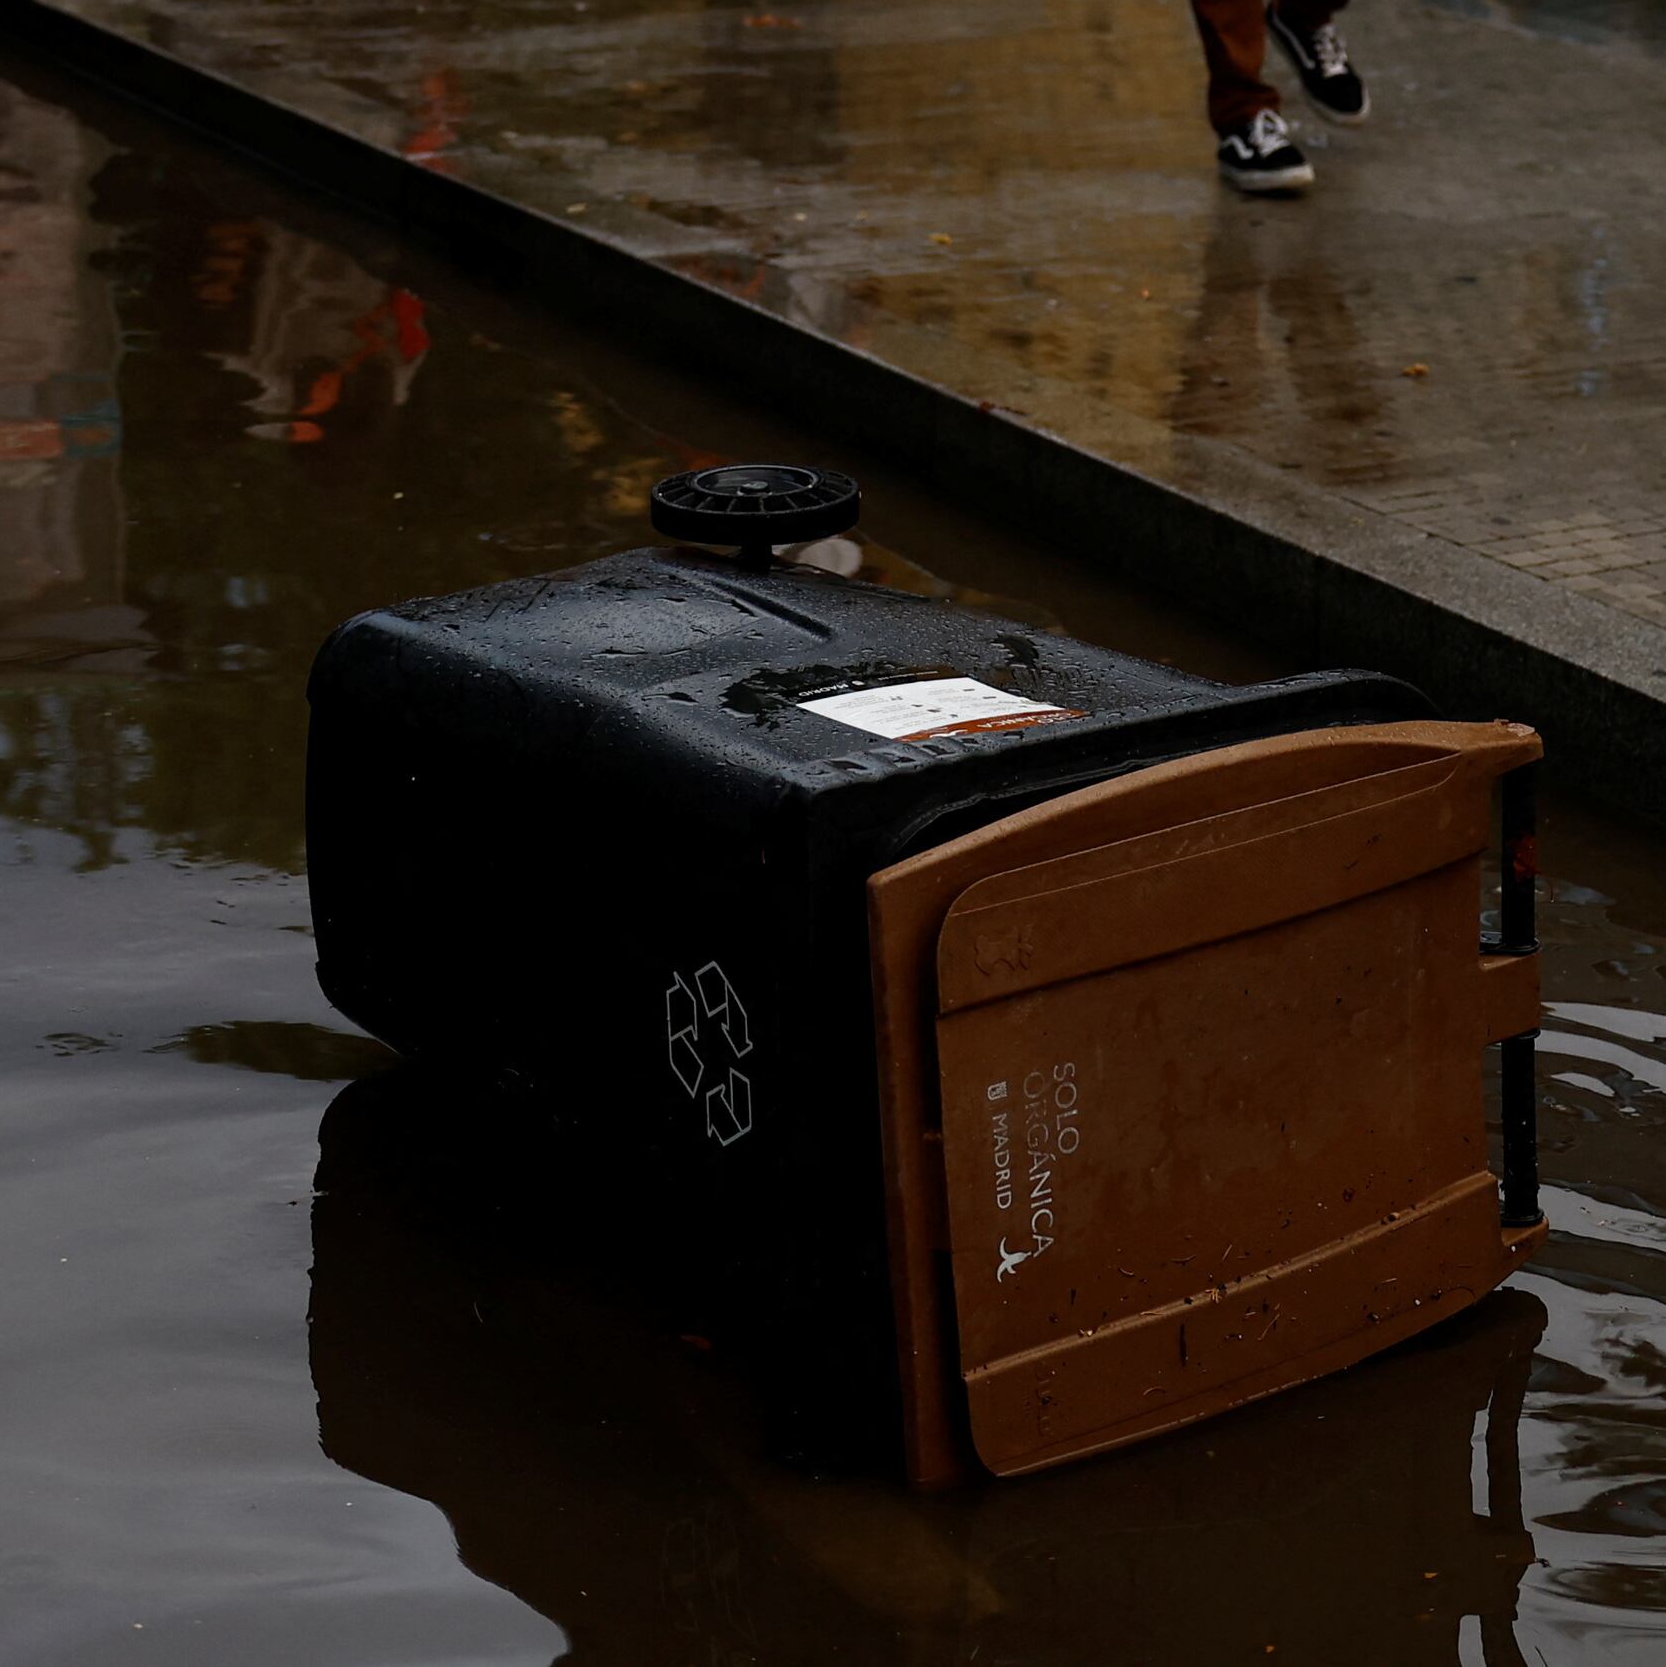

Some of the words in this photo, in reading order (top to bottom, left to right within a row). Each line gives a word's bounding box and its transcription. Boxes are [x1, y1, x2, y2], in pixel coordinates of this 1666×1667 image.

[1052, 1061, 1080, 1155] SOLO
[991, 1111, 1013, 1210] MADRID
[1022, 1070, 1057, 1259] ORGÁNICA
